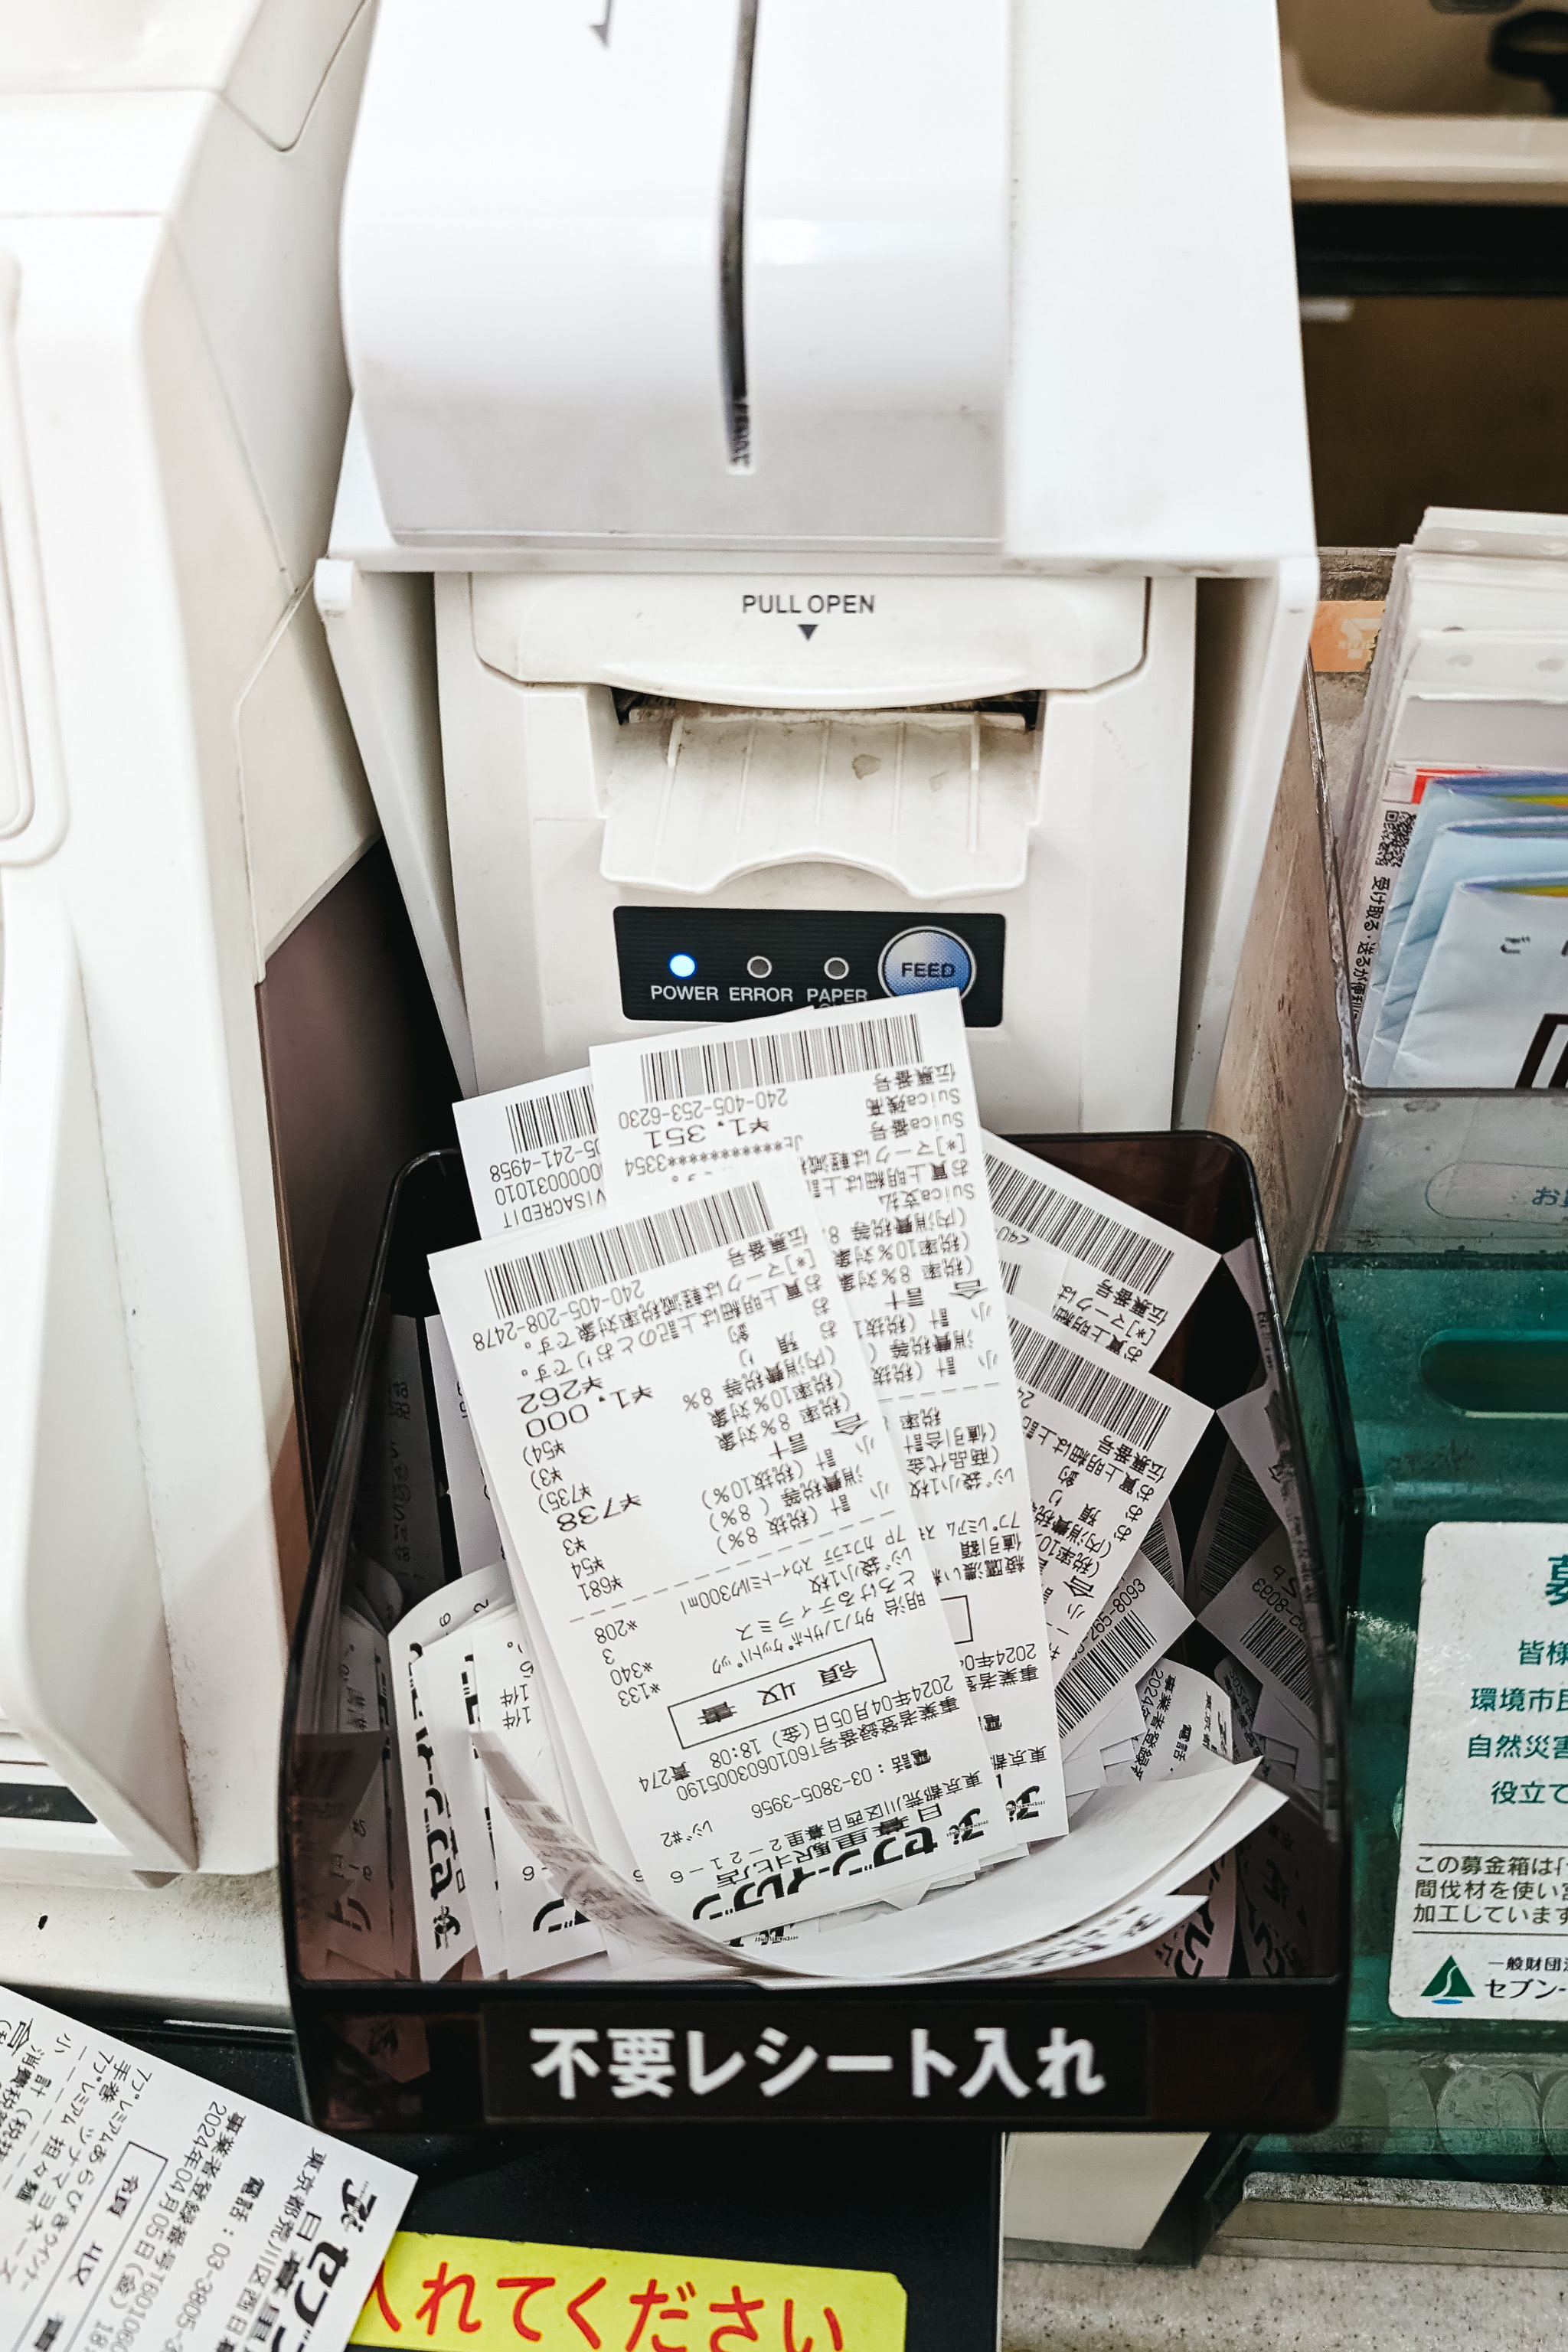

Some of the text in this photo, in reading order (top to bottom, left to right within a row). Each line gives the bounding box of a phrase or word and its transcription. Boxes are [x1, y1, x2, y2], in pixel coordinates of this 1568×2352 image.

[742, 594, 875, 614] PULL OPEN
[900, 962, 956, 979] FEED
[651, 985, 719, 1003] POWER
[729, 987, 793, 1004] ERROR
[806, 988, 868, 1007] PAPER
[617, 1063, 956, 1130] 伝票番号 240-405-253-6230
[865, 1087, 960, 1118] Suica残高
[869, 1111, 964, 1142] Suica番号
[494, 1162, 604, 1207] 0000031010
[877, 1182, 975, 1213] Suica支払
[1532, 1187, 1568, 1207] お
[503, 1187, 607, 1230] VISACREDIT
[472, 1227, 808, 1351] 伝票番号 240-405-208-2478
[1095, 1279, 1169, 1327] 伝票番号
[521, 1273, 822, 1384] お買上明細は上記のとおりです。
[1051, 1304, 1143, 1364] お買上明細
[517, 1375, 603, 1415] ¥262
[556, 1412, 869, 1533] 合計 ¥738
[1097, 1434, 1168, 1484] 伝票番号
[884, 1524, 906, 1546] 7P
[1030, 1498, 1112, 1559] (内消費税
[562, 1537, 587, 1557] ¥3
[959, 1532, 1022, 1560] 値引額
[1034, 1533, 1100, 1579] (税率10
[570, 1556, 606, 1579] ¥54
[577, 1574, 624, 1601] ¥681
[735, 1570, 915, 1642] とろけるティラミス
[884, 1590, 926, 1617] 明治
[602, 1648, 616, 1665] 3
[977, 1713, 1003, 1733] 電
[709, 1738, 762, 1769] 18:08
[691, 1826, 939, 1921] セブン-イレブン
[1416, 1855, 1568, 1876] この募金箱は「
[529, 2027, 1107, 2100] 不要レシート入れ
[98, 2060, 132, 2103] 手巻
